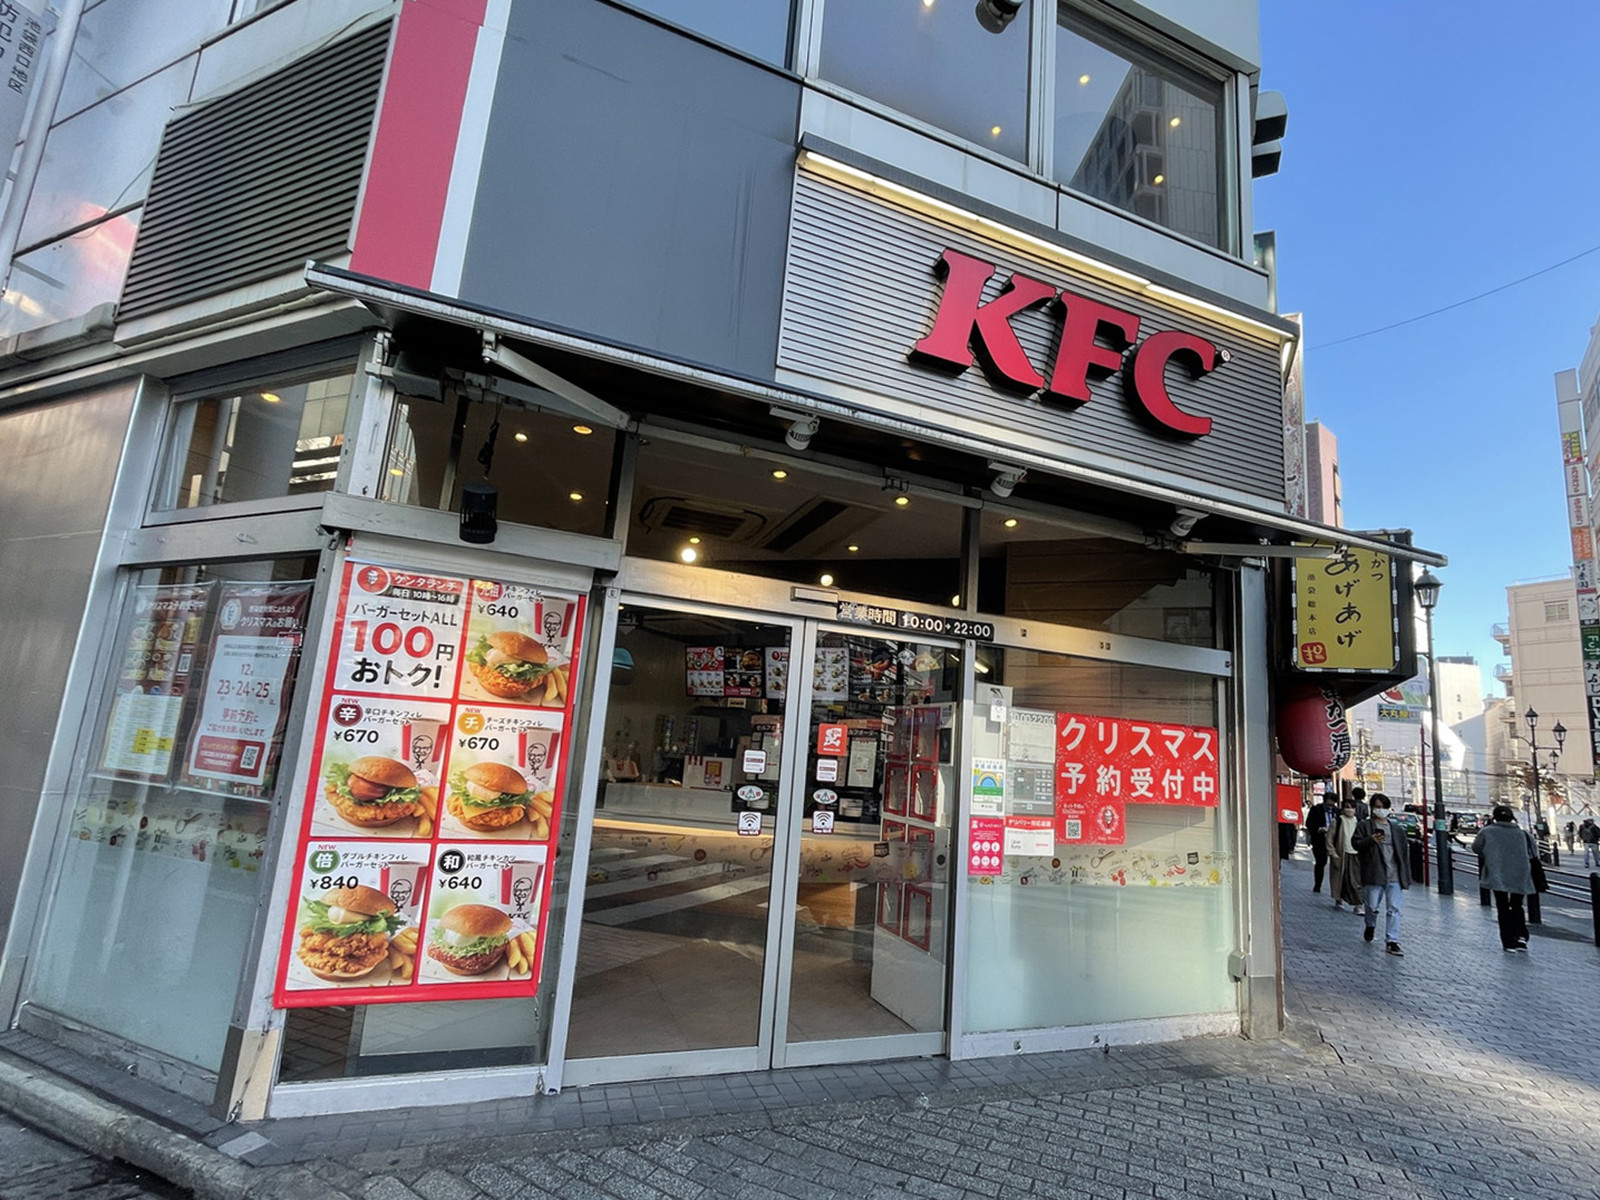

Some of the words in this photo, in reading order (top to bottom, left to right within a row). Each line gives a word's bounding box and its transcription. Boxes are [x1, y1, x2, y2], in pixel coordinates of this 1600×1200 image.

[914, 247, 1217, 435] KFC
[1371, 552, 1386, 582] かつ
[478, 603, 519, 619] ¥640
[839, 602, 897, 626] 営業時間
[953, 621, 991, 637] 22:00
[350, 620, 455, 661] 100円
[351, 657, 442, 688] おトク!
[339, 706, 357, 722] 辛
[333, 729, 380, 744] ¥670
[458, 737, 500, 751] ¥670
[1061, 717, 1215, 762] クリスマス
[1061, 762, 1215, 802] 予約受付中
[315, 852, 334, 869] 倍
[442, 853, 461, 870] 和
[310, 875, 360, 890] ¥840
[439, 876, 483, 890] ¥640
